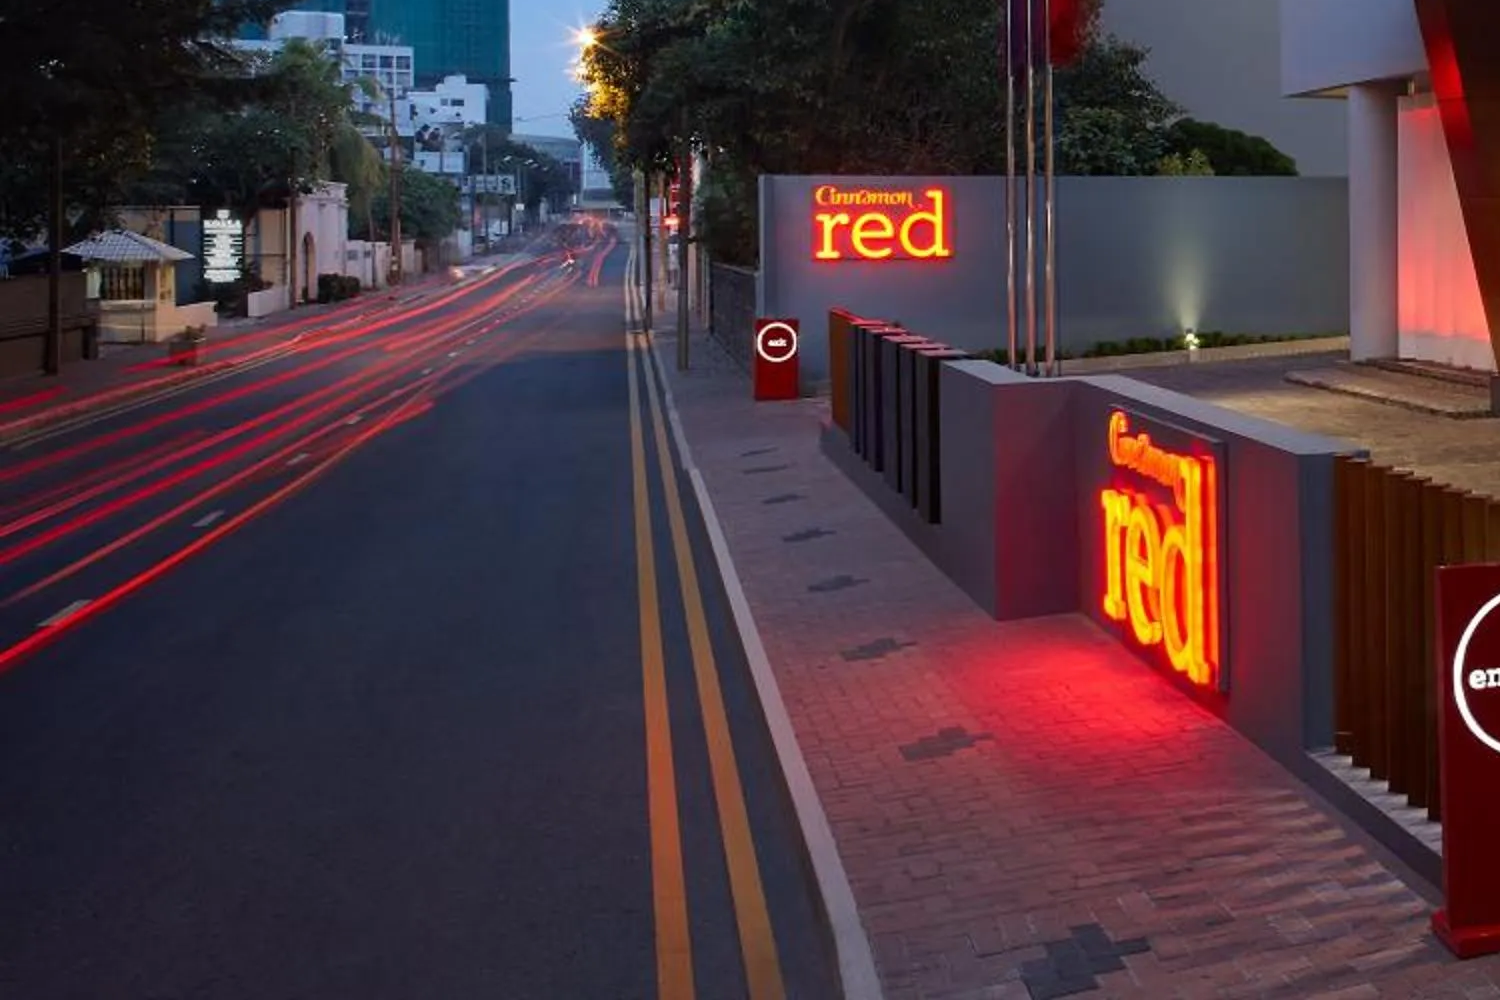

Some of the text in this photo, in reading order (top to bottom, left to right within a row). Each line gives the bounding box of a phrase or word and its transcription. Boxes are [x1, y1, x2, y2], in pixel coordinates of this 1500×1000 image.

[815, 185, 913, 207] Cinnamon
[815, 189, 950, 260] red
[1101, 456, 1214, 685] red
